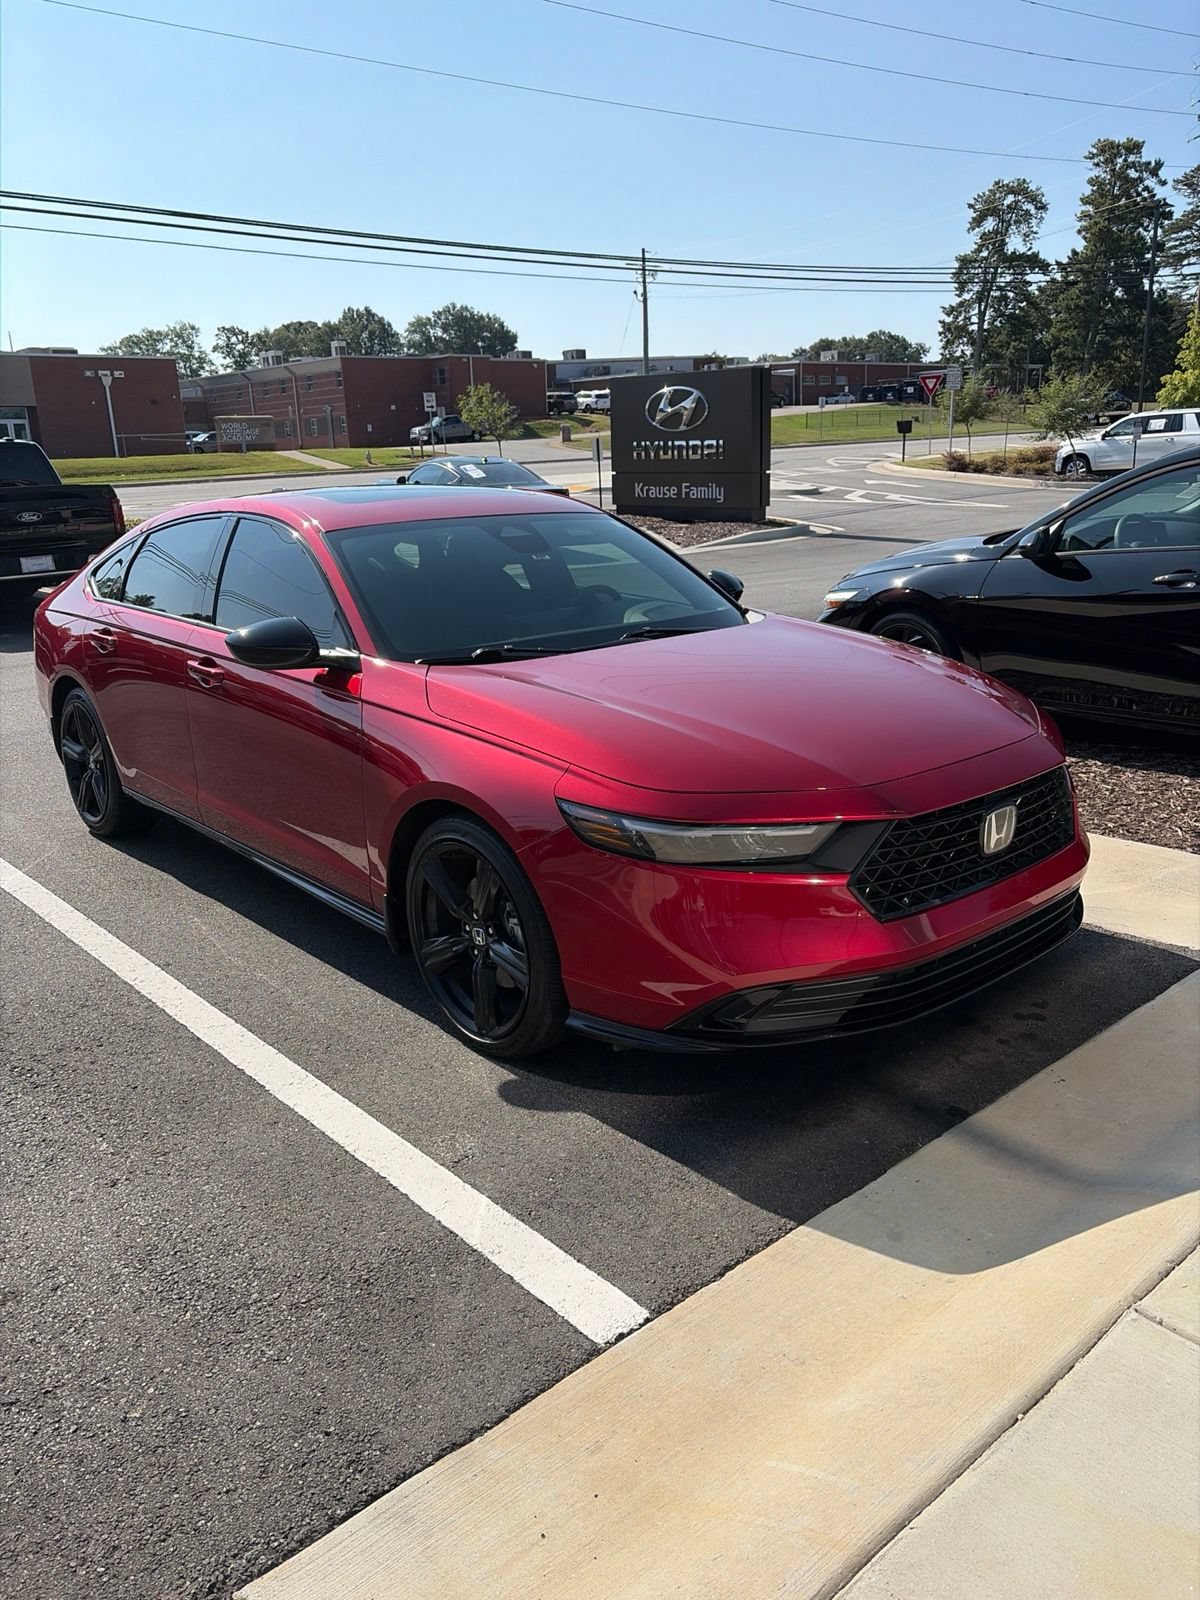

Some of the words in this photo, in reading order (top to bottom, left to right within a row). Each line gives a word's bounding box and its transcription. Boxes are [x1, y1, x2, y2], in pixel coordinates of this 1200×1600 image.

[220, 422, 248, 430] WORLD
[222, 434, 257, 442] ACADMY
[633, 439, 724, 460] HYUNDAI
[634, 482, 678, 498] Krause
[682, 482, 724, 503] Family
